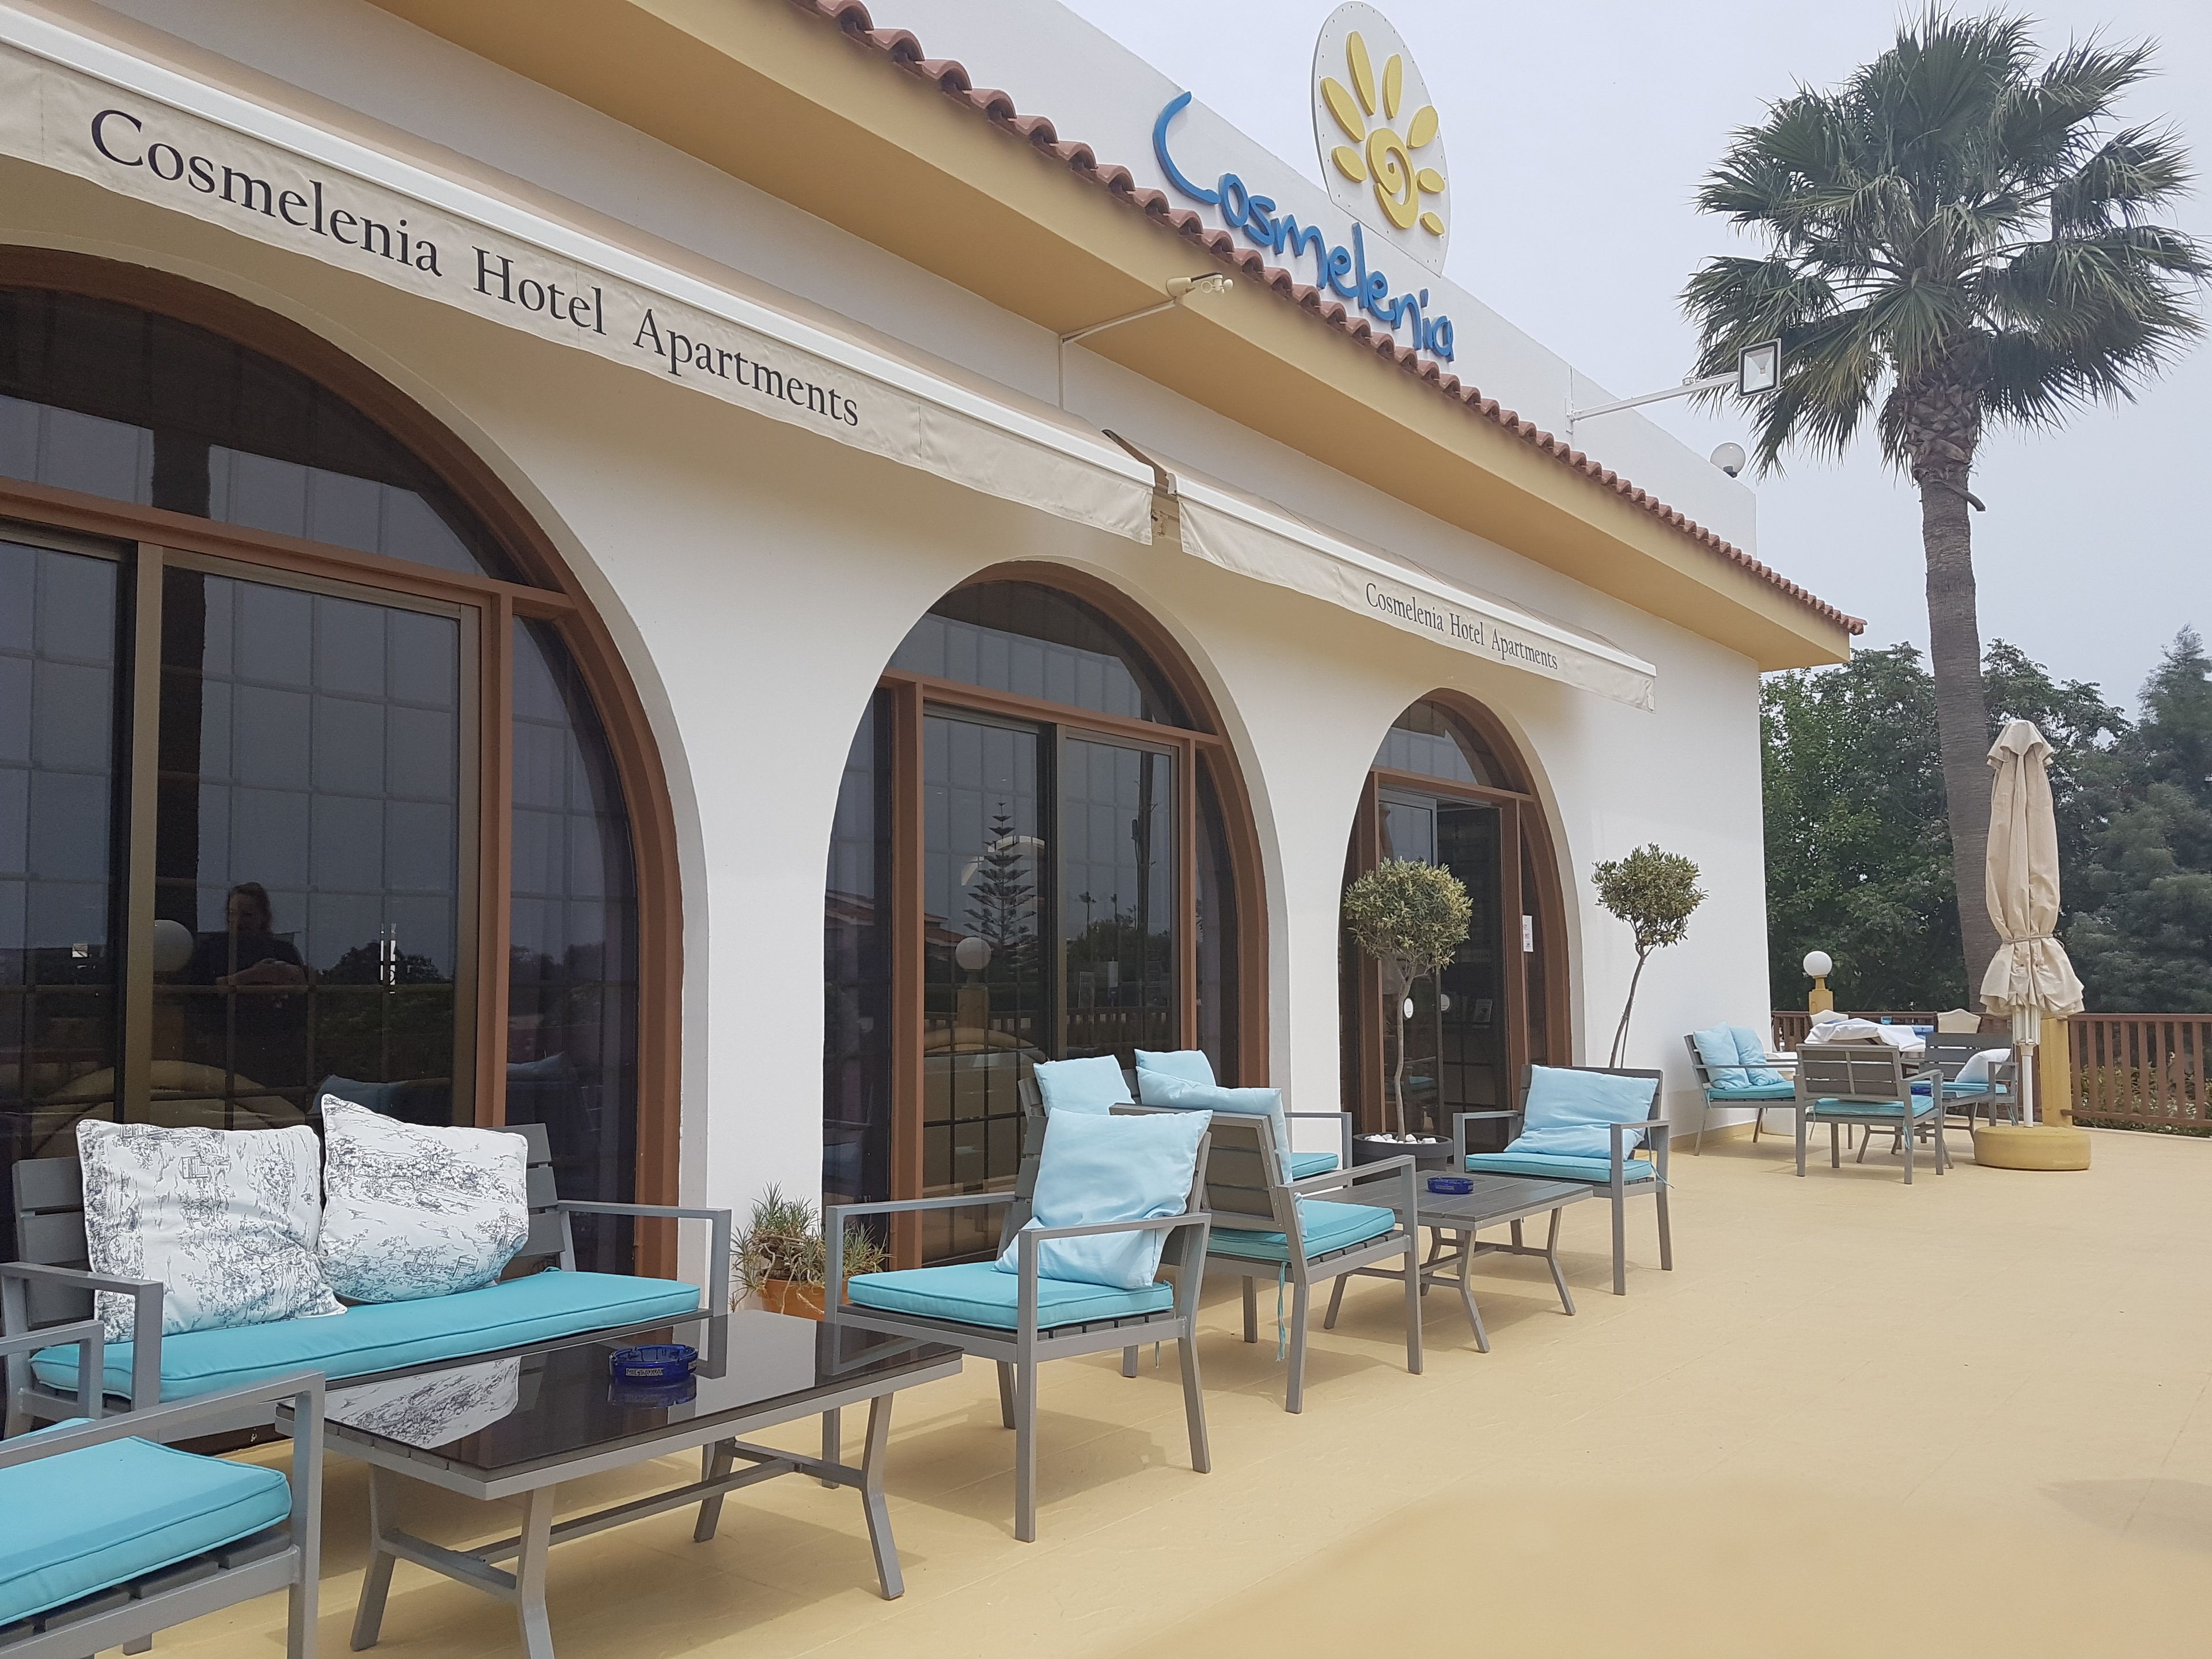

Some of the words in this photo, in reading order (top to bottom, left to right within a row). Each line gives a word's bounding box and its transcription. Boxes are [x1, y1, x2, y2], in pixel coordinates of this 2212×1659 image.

[91, 109, 442, 276] Cosmelenia
[471, 245, 607, 335] Hotel
[632, 308, 859, 426] Apartments
[1153, 90, 1455, 362] Cosmelenia
[1366, 582, 1444, 632] Cosmelenia
[1449, 612, 1485, 645] Hotel
[1491, 628, 1558, 670] Apartments
